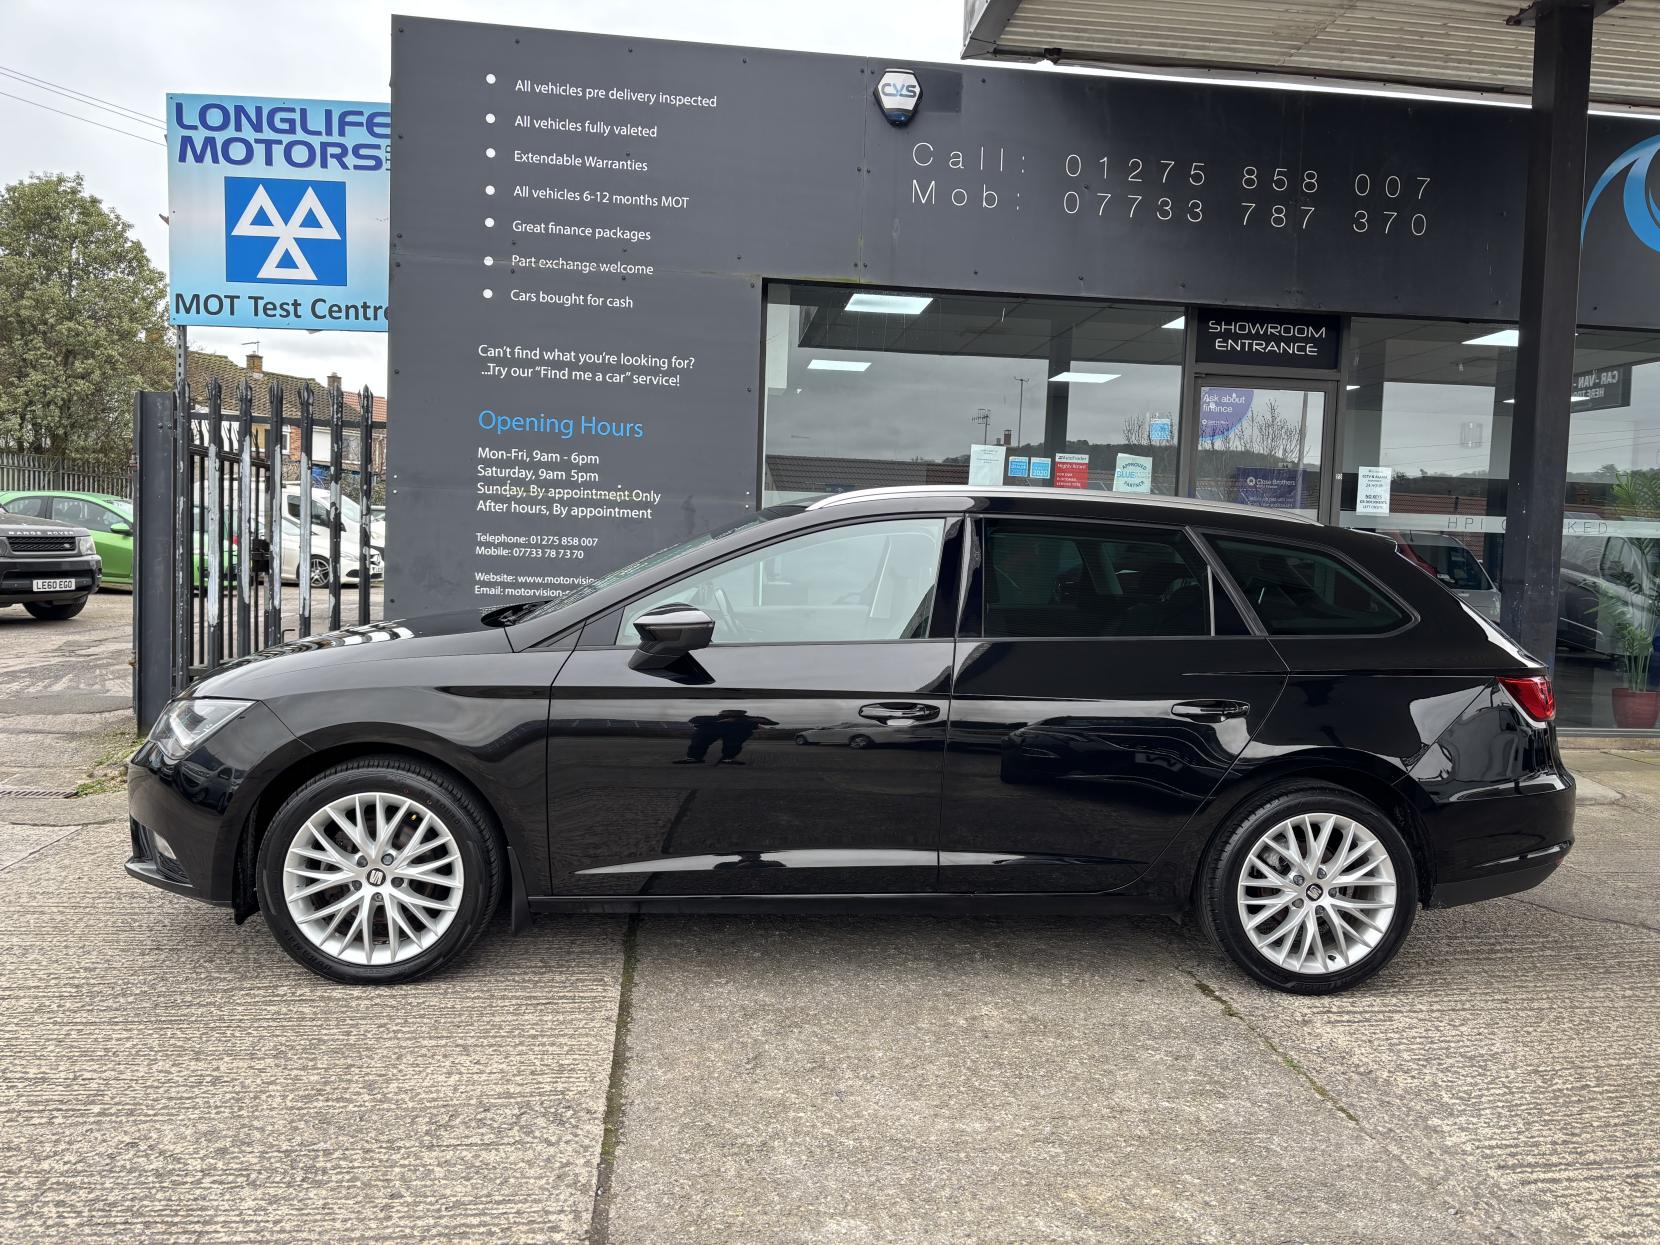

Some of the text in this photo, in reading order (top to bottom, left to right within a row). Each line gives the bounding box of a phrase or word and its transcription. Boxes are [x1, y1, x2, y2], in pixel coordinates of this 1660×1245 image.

[515, 80, 717, 107] All vehicles pre delivery inspected
[175, 102, 391, 140] LONGLIFE
[515, 115, 658, 138] All vehicles fully valeted
[178, 135, 384, 172] MOTORS
[513, 150, 648, 172] Extendable Warranties
[1242, 166, 1319, 193] 858
[1354, 173, 1431, 200] 007
[513, 186, 689, 208] All vehicles 6-12 months MOT
[1241, 202, 1316, 230] 787
[1352, 210, 1427, 236] 370
[512, 220, 651, 243] Great finance packages
[511, 255, 654, 276] Part exchange welcome
[174, 292, 241, 317] MOT
[247, 295, 302, 319] Test
[510, 289, 634, 309] Cars bought for cash
[1208, 320, 1326, 340] SHOWROOM
[1215, 338, 1318, 356] ENTRANCE
[478, 344, 696, 371] Can't find what you're looking for?
[510, 366, 534, 378] our
[571, 370, 593, 382] me
[595, 373, 604, 383] a
[632, 373, 681, 388] service!
[1203, 393, 1246, 404] Ask about
[1203, 403, 1233, 413] finance
[479, 410, 644, 439] Opening Hours
[478, 447, 530, 462] Mon-Fri,
[533, 450, 560, 463] 9am
[571, 453, 600, 466] 6pm
[477, 465, 599, 484] Saturday, 9am 5pm
[1116, 470, 1136, 479] BLUE
[477, 483, 661, 505] Sunday, By appointment Only
[477, 501, 652, 519] After hours, By appointment
[1447, 517, 1483, 529] HPI
[476, 533, 598, 547] Telephone: 01275 858 007
[476, 547, 511, 557] Mobile:
[513, 548, 542, 558] 07733
[36, 581, 73, 590] LE60 EGO
[475, 573, 516, 583] Website:
[475, 586, 572, 598] Email: motorvision-
